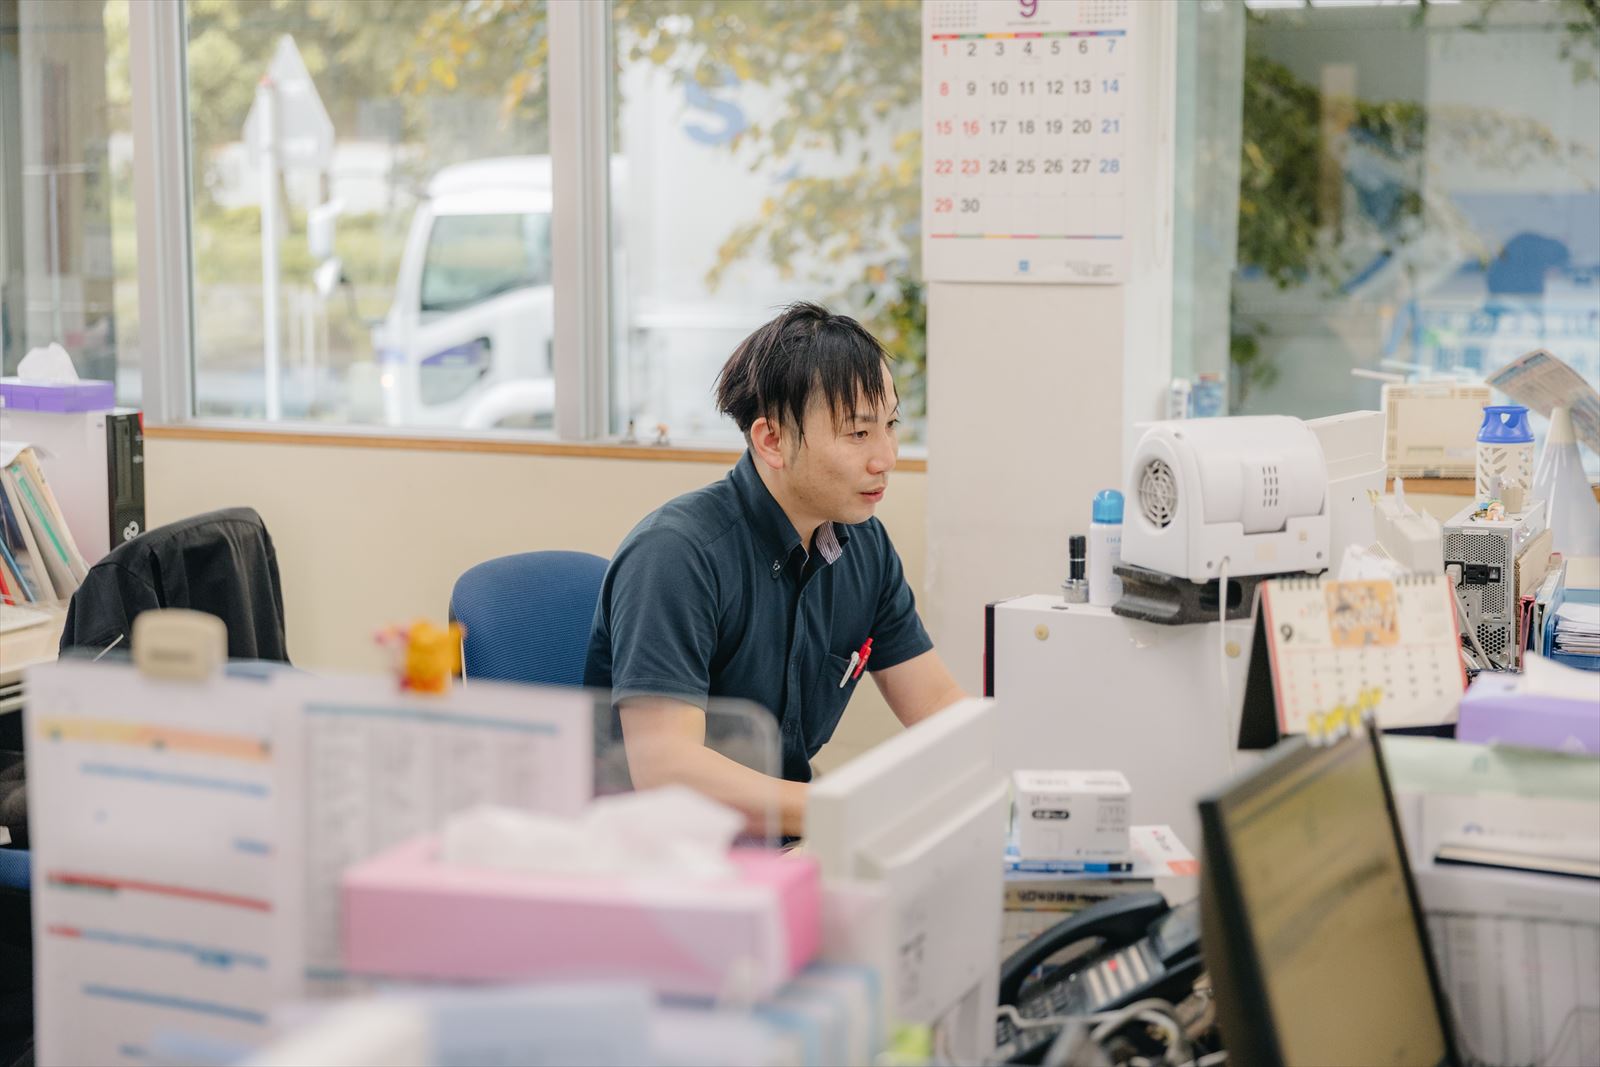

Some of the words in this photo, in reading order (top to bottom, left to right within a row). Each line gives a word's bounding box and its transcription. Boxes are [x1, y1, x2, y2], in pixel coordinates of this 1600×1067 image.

[942, 43, 948, 57] 1
[967, 42, 978, 57] 2
[995, 42, 1005, 56] 3
[1023, 41, 1033, 56] 4
[1051, 41, 1061, 55] 5
[1079, 40, 1089, 54] 6
[1106, 39, 1116, 53] 7
[940, 82, 950, 97] 8
[967, 81, 977, 96] 9
[992, 81, 1009, 96] 10
[1021, 81, 1035, 95] 11
[1048, 81, 1064, 96] 12
[1075, 80, 1091, 95] 13
[1102, 80, 1120, 94] 14
[937, 121, 953, 136] 15
[964, 121, 980, 136] 16
[991, 121, 1008, 135] 17
[1018, 121, 1036, 135] 18
[1046, 121, 1063, 135] 19
[1073, 120, 1092, 135] 20
[1102, 120, 1120, 134] 21
[936, 160, 953, 175] 22
[962, 160, 980, 175] 23
[990, 161, 1008, 175] 24
[1017, 160, 1036, 175] 25
[1045, 160, 1064, 175] 26
[1073, 160, 1092, 175] 27
[1100, 160, 1120, 174] 28
[935, 199, 954, 214] 29
[961, 200, 981, 214] 30
[1280, 624, 1294, 643] 9
